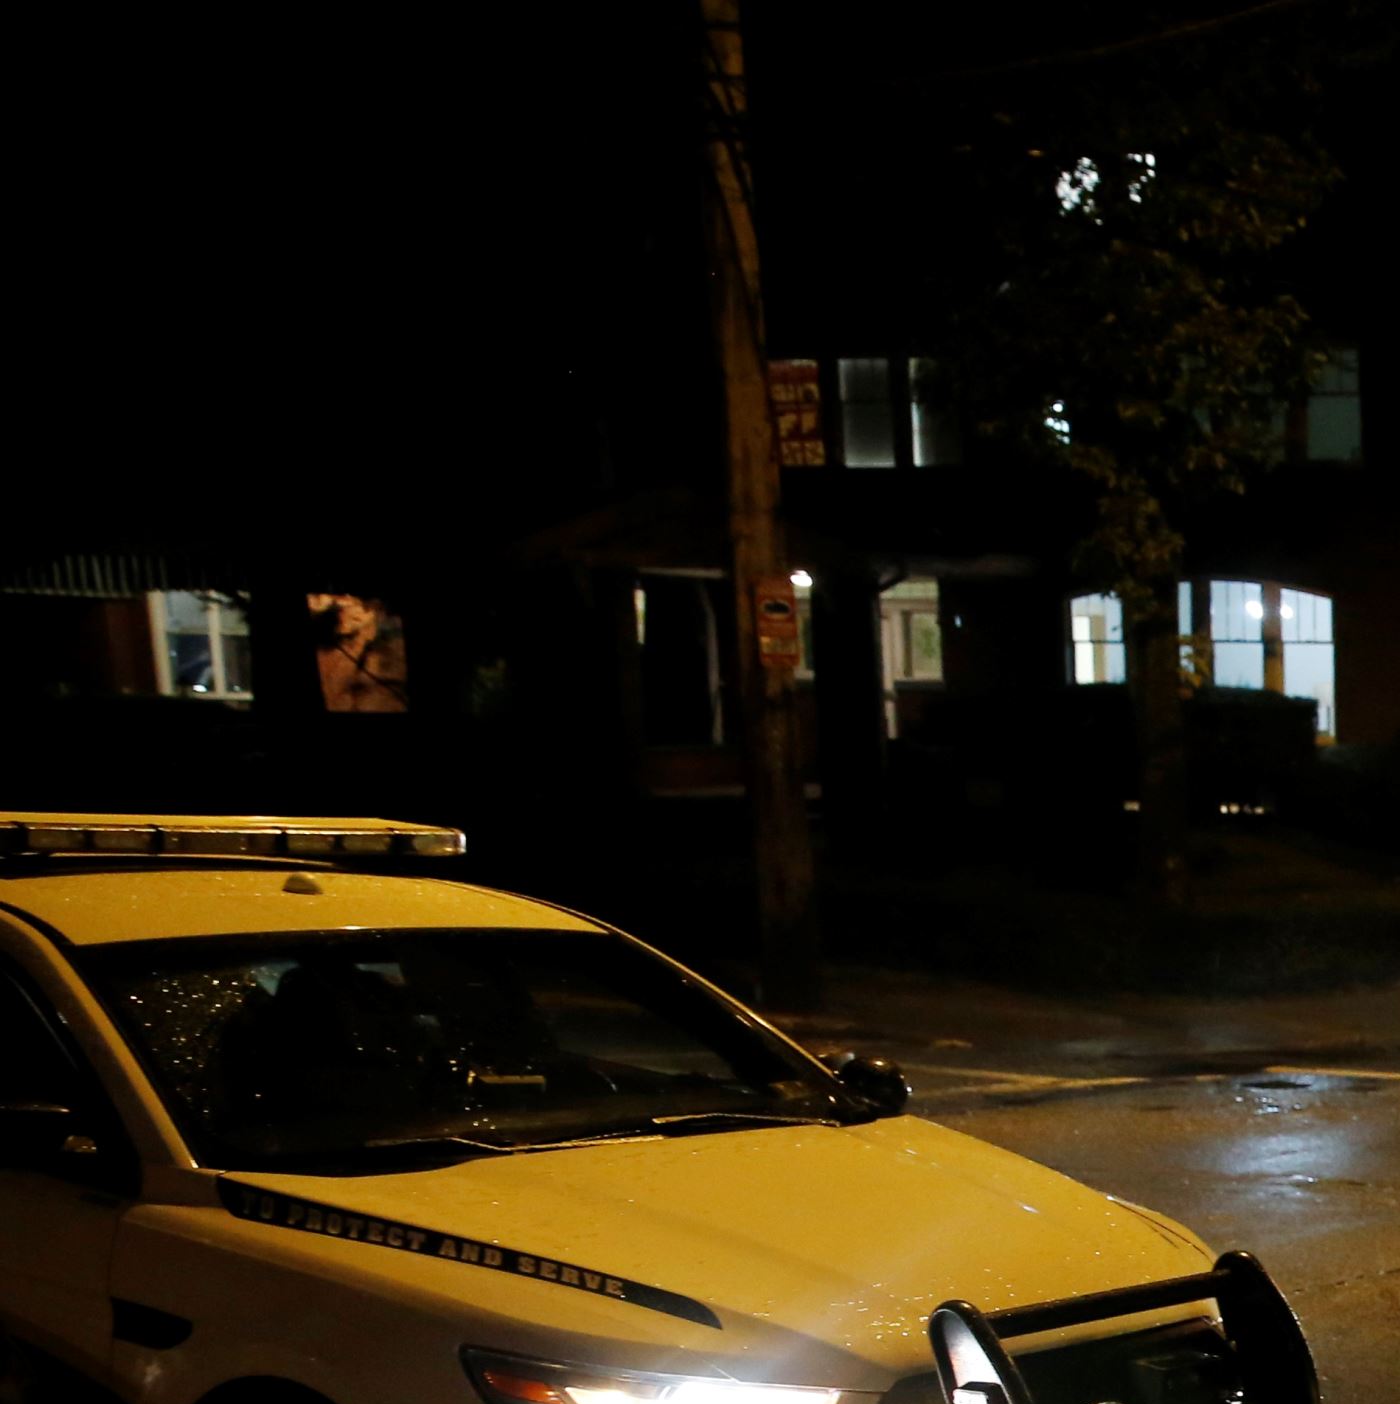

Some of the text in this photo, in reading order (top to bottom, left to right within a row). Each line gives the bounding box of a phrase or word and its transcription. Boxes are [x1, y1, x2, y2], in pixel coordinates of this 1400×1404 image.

[240, 1190, 627, 1298] TO PROTECT AND SERVE
